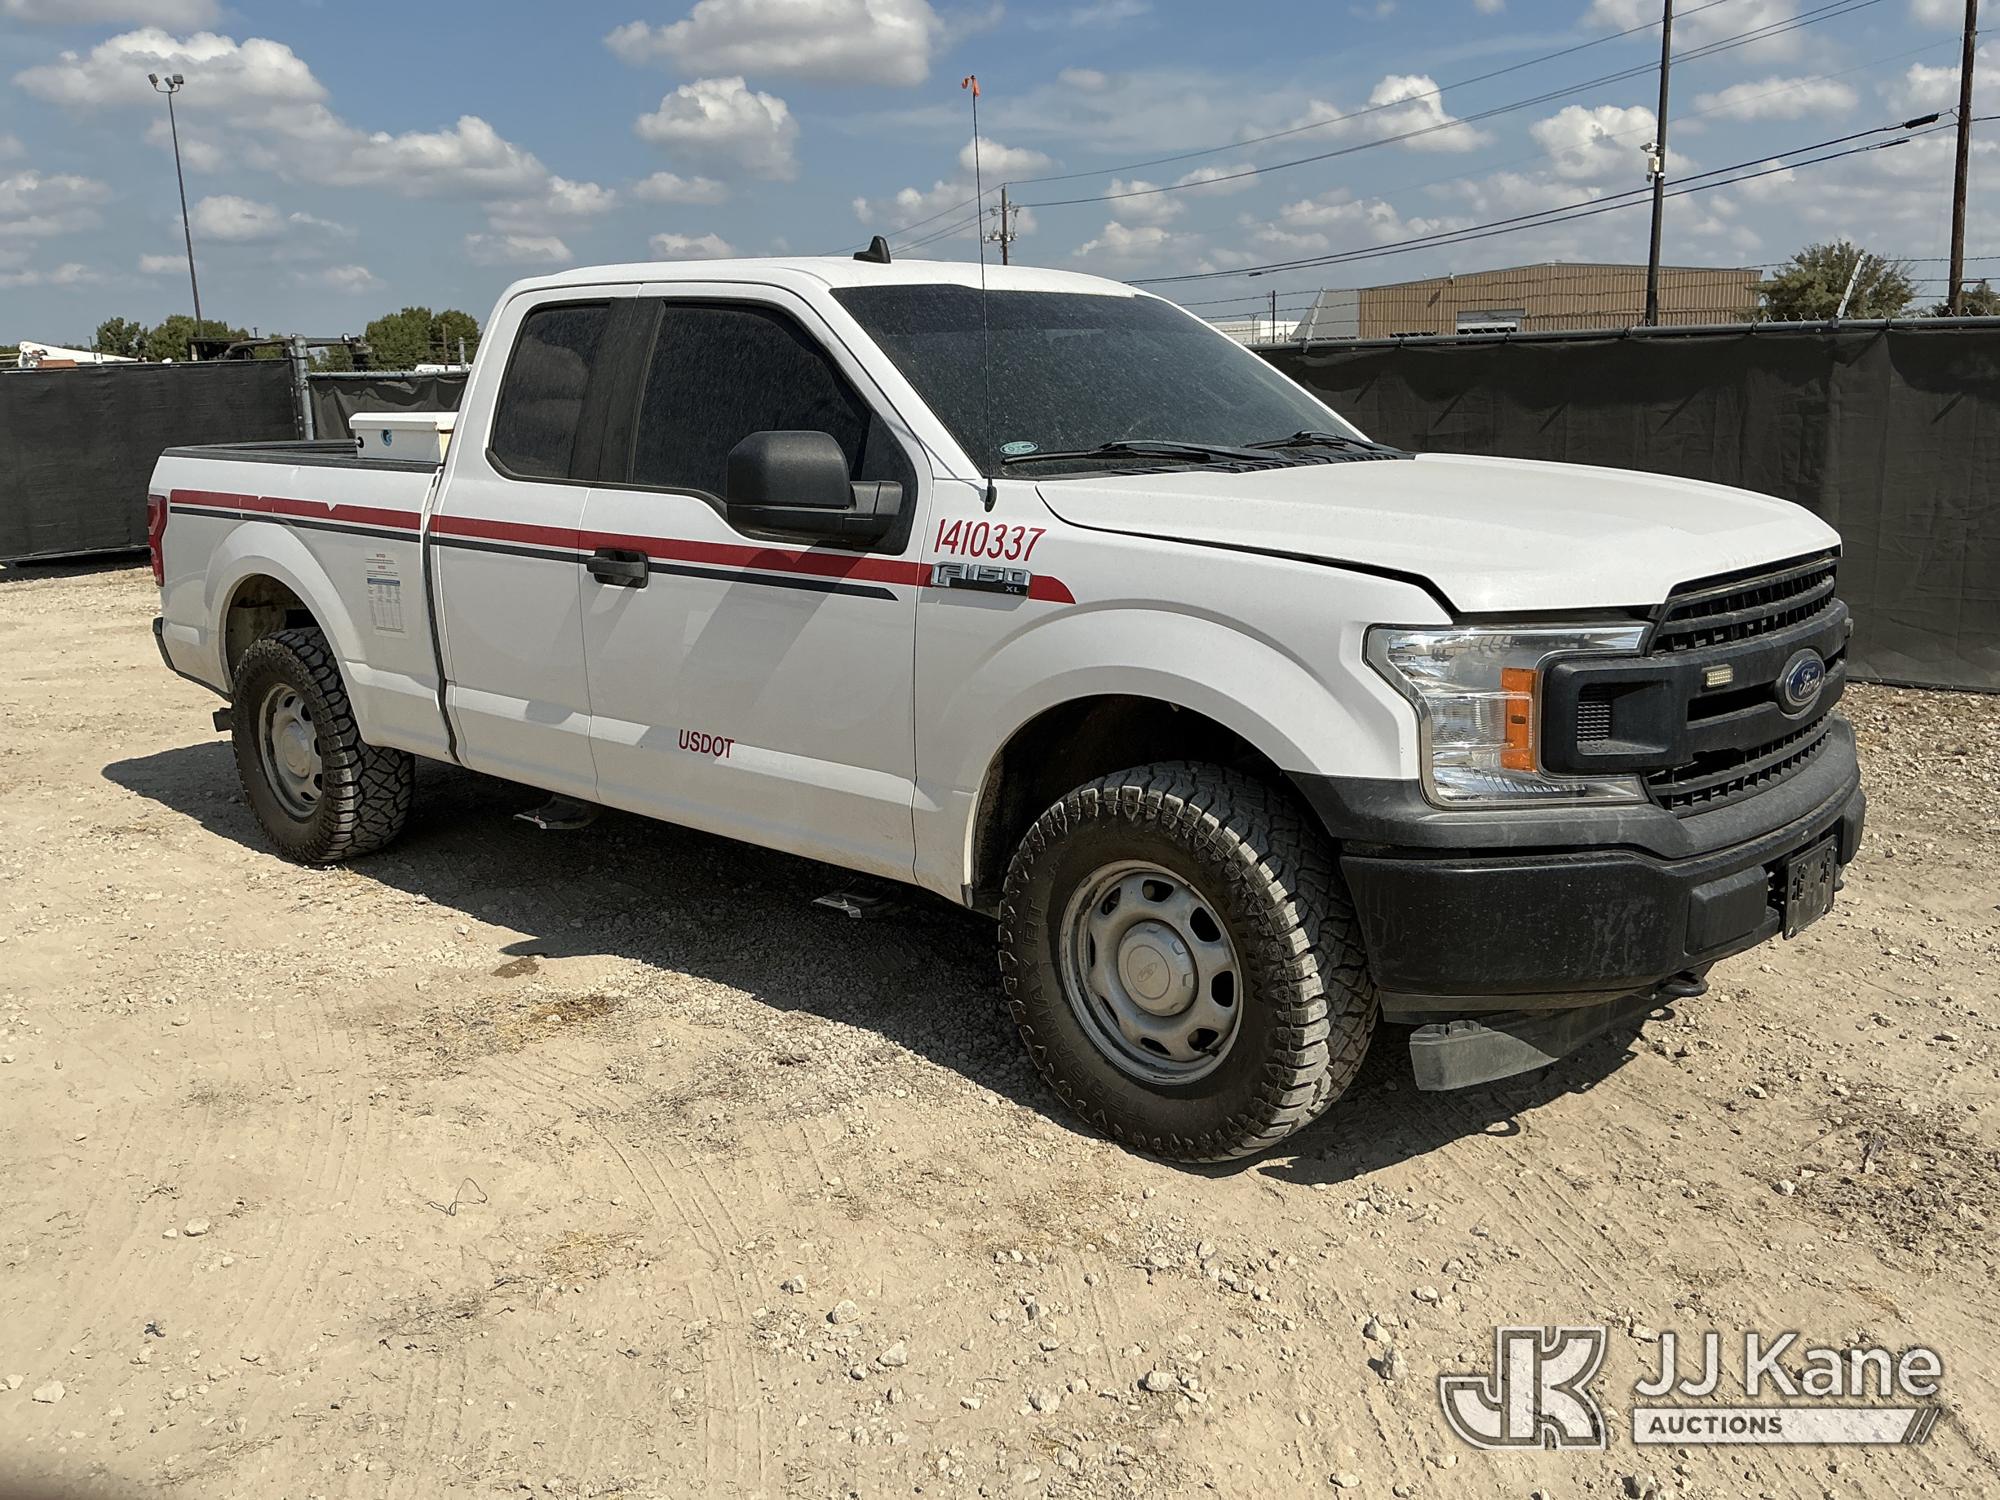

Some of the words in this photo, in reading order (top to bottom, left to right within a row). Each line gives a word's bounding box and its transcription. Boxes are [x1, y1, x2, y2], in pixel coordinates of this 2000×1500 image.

[934, 518, 1047, 562] 1410337
[1005, 585, 1020, 593] XL
[1798, 666, 1820, 696] Ford
[679, 728, 735, 759] USDOT
[1022, 896, 1043, 947] RT
